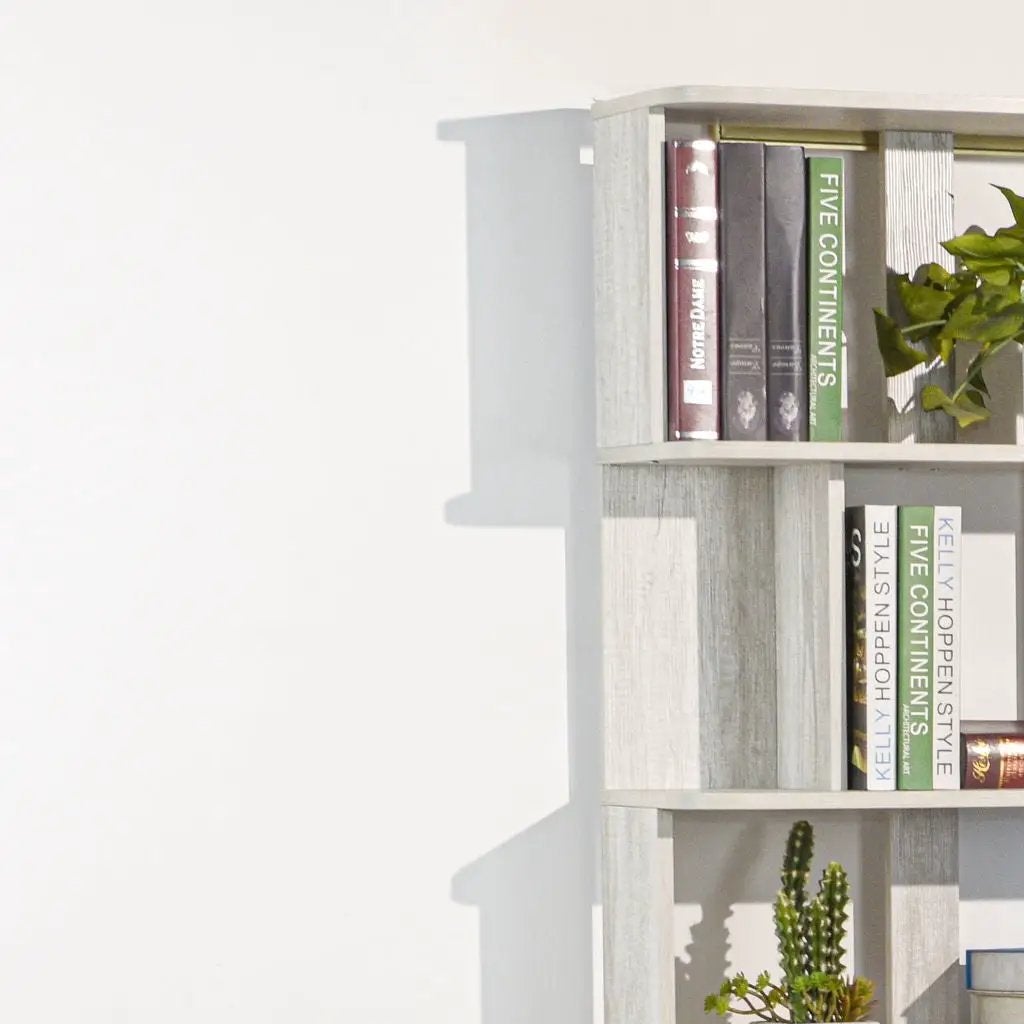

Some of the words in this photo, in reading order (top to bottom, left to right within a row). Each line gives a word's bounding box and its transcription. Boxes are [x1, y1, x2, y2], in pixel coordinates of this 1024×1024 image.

[818, 173, 839, 225] FIVE
[817, 233, 839, 387] CONTINENTS
[873, 522, 890, 595] STYLE
[910, 525, 929, 576] FIVE
[937, 517, 954, 590] KELLY
[873, 603, 890, 700] HOPPEN
[909, 584, 929, 736] CONTINENTS
[936, 598, 953, 694] HOPPEN
[875, 709, 891, 781] KELLY
[902, 760, 910, 775] ART
[936, 703, 953, 776] STYLE
